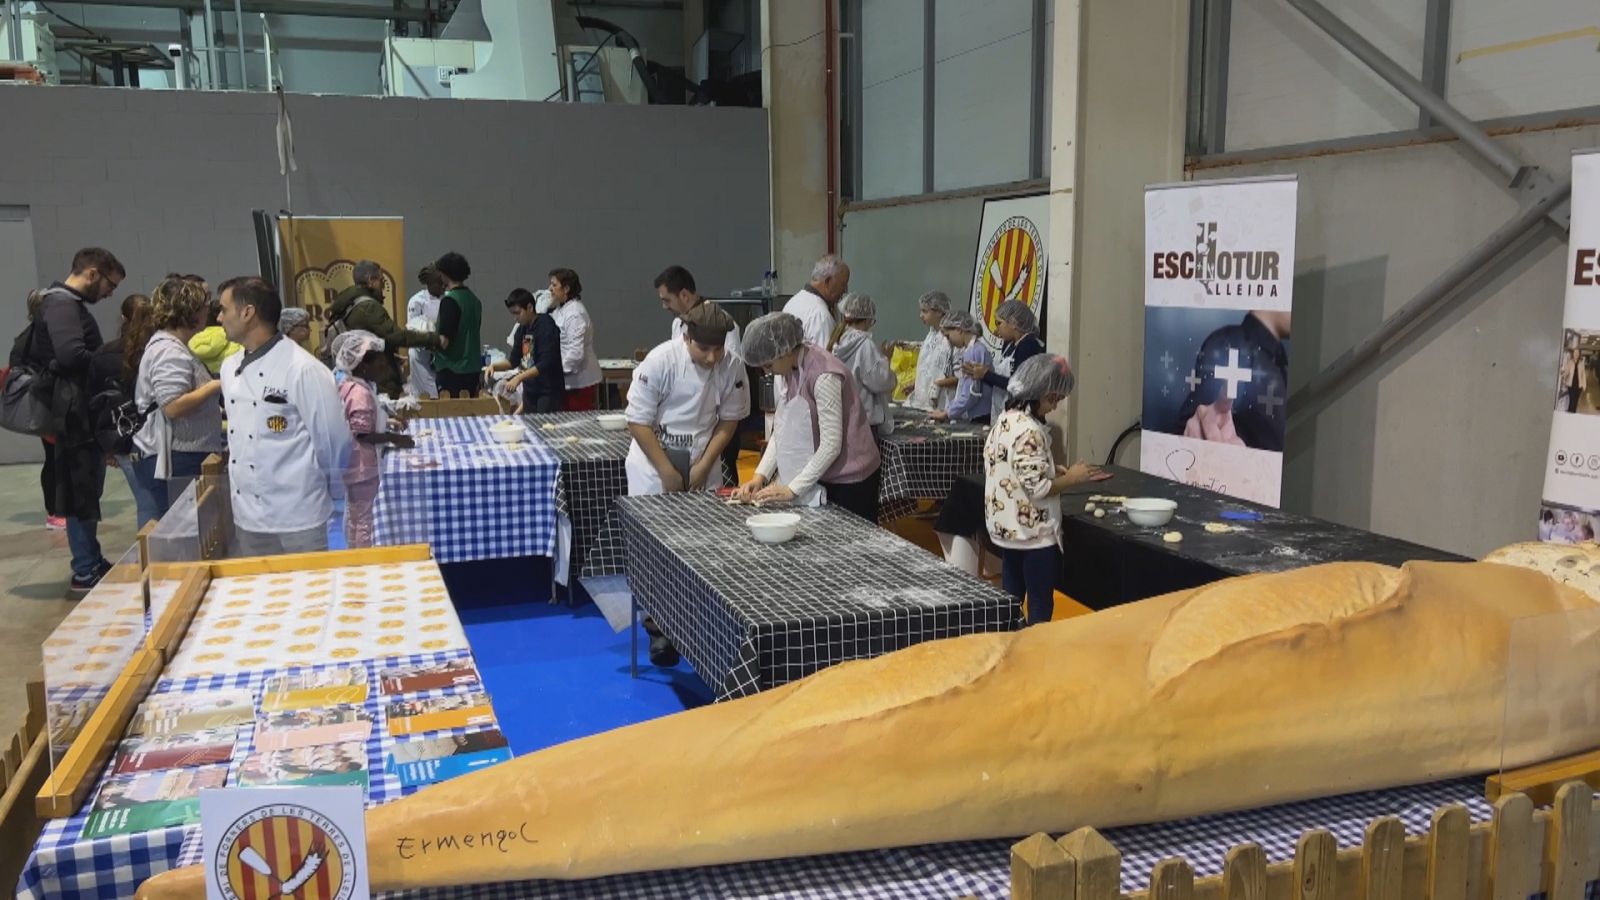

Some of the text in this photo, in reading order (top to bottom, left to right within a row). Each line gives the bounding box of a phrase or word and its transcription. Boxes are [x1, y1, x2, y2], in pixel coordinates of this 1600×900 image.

[1574, 248, 1600, 286] E
[1216, 283, 1278, 297] LLEIDA
[220, 813, 258, 858] FORNERS
[261, 807, 275, 818] DE
[282, 805, 304, 816] LES
[310, 812, 345, 848] TERRES
[342, 852, 351, 867] DE
